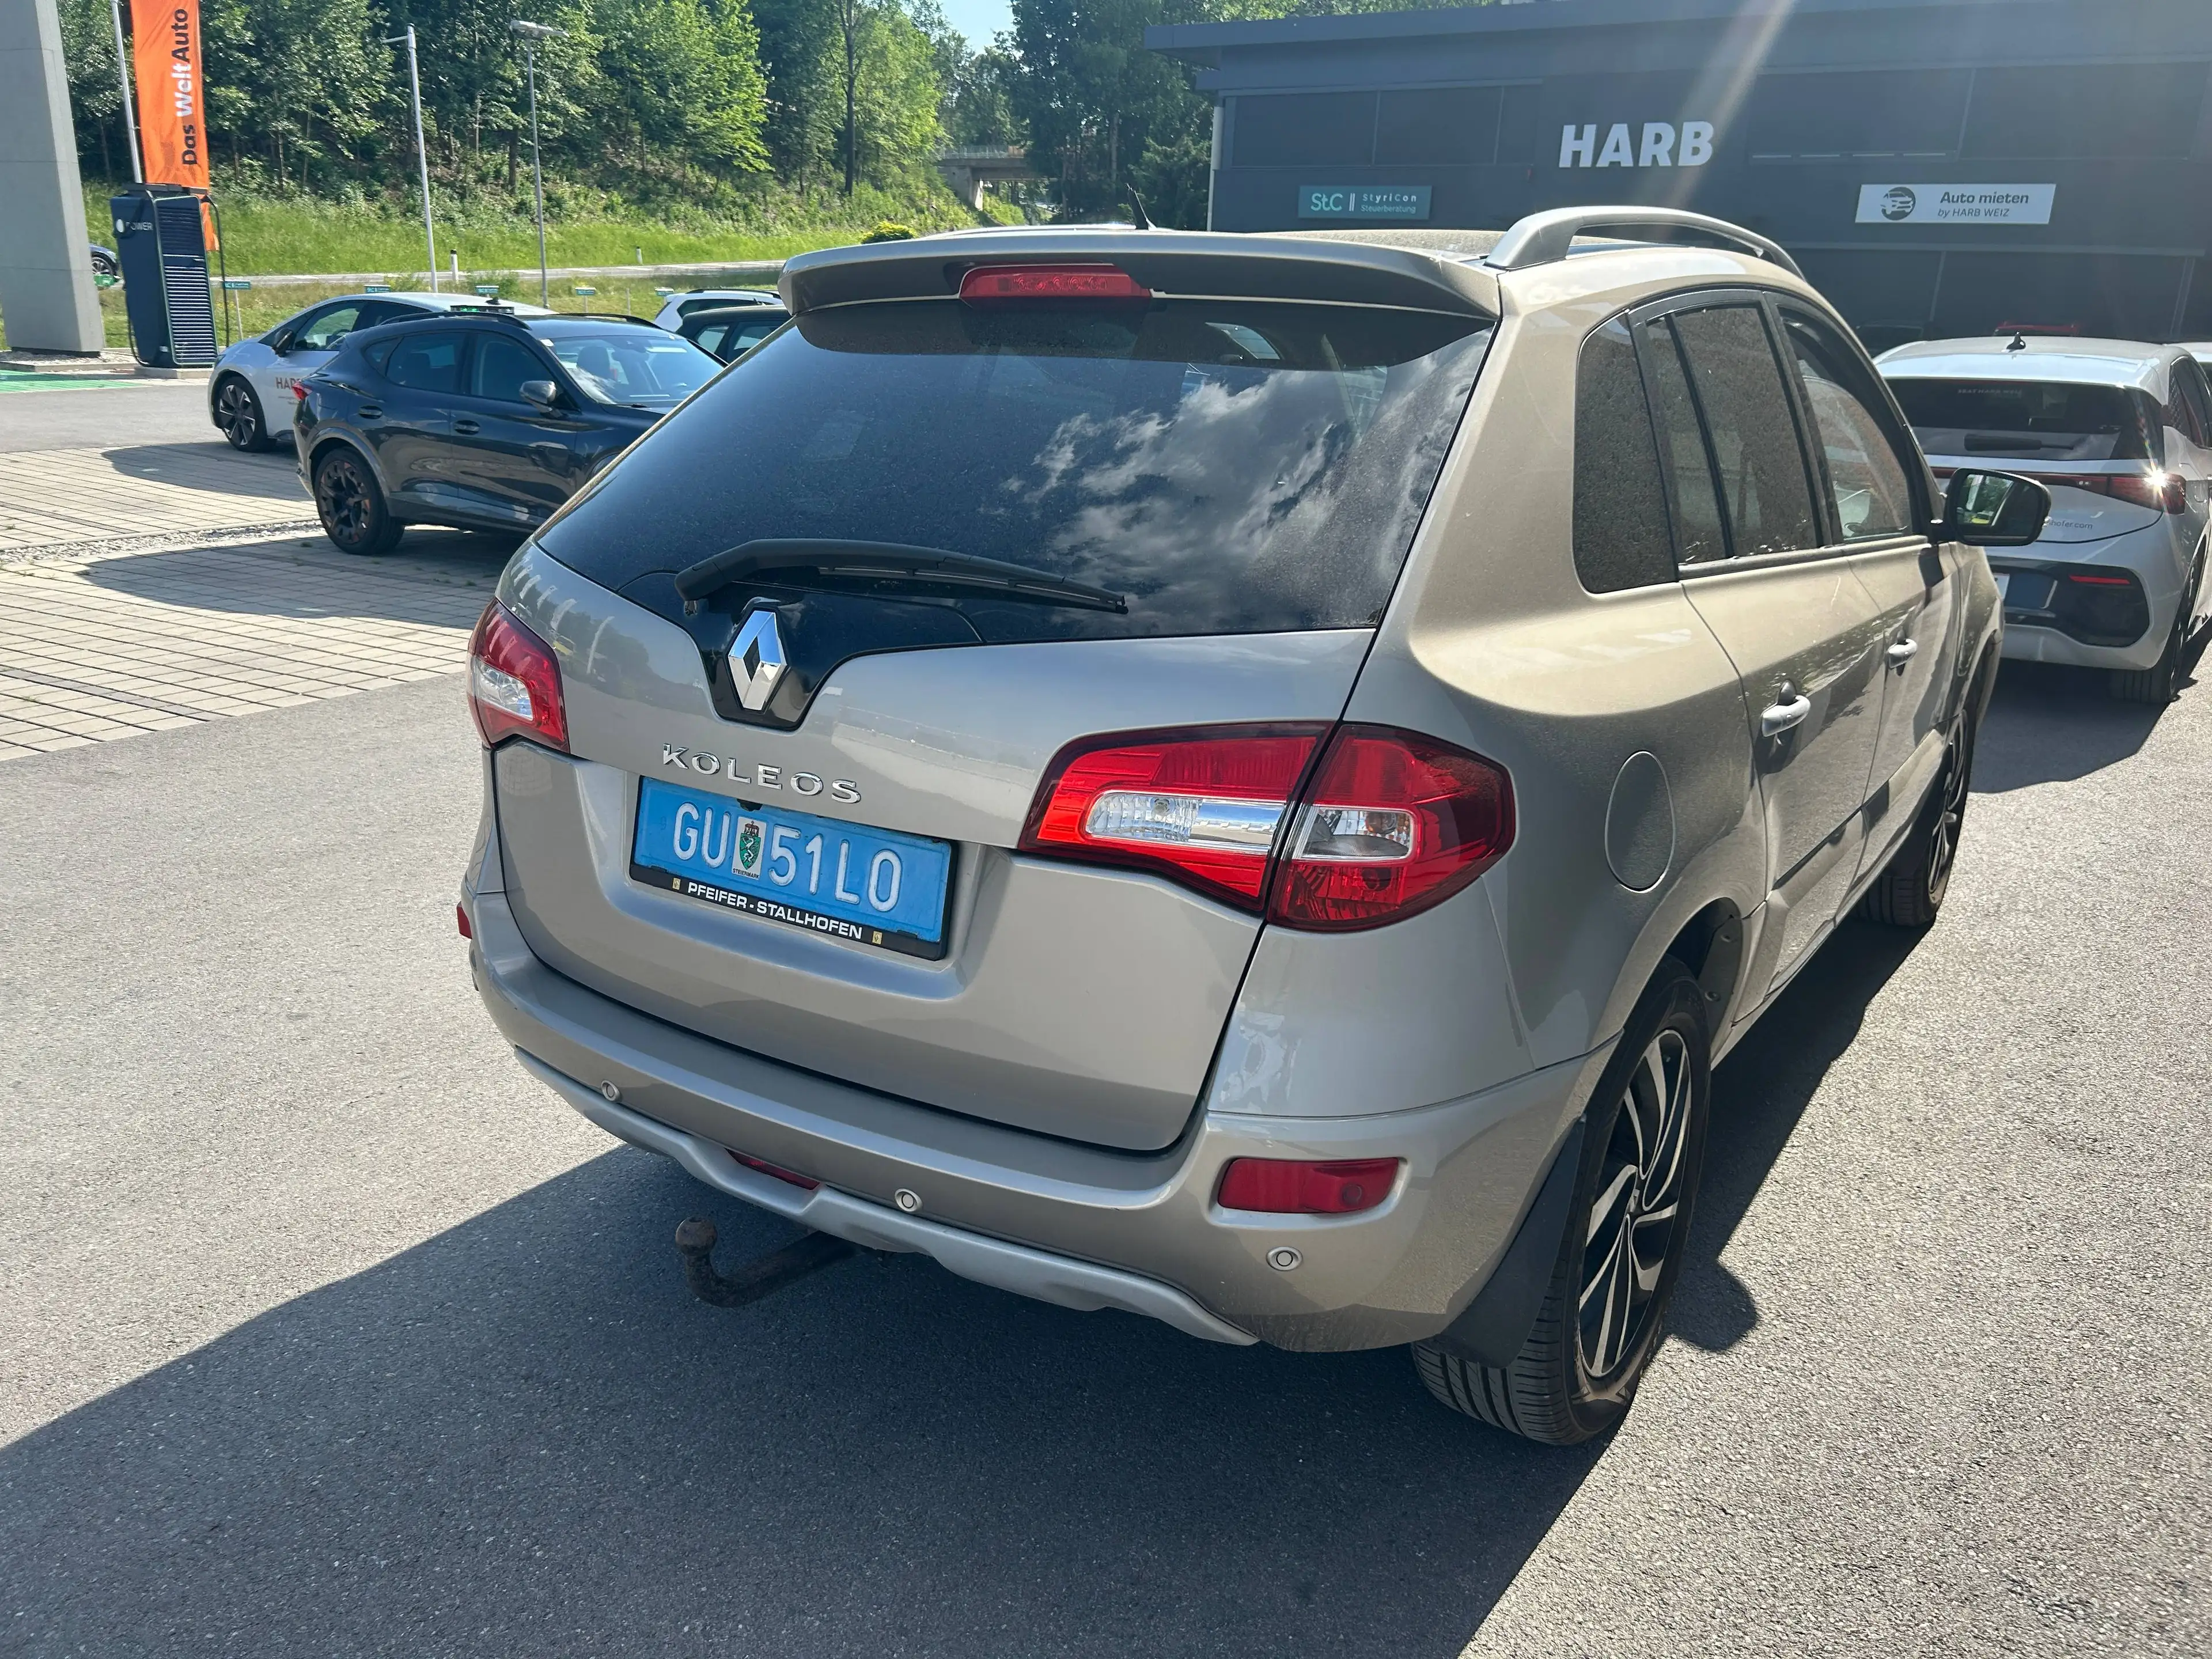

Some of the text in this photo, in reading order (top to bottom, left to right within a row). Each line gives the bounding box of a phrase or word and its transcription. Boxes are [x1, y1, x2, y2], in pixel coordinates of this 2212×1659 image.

[171, 9, 197, 165] Das WeltAuto
[1559, 120, 1714, 168] HARB
[1310, 192, 1343, 211] StC
[1940, 191, 2029, 204] Auto mieten
[1361, 204, 1416, 214] Steuerberatung
[1937, 208, 2010, 219] by HARB WEIZ
[275, 377, 301, 390] HAR
[663, 743, 862, 804] KOLEOS
[673, 803, 730, 868] GU
[732, 868, 760, 880] STEIERMARK
